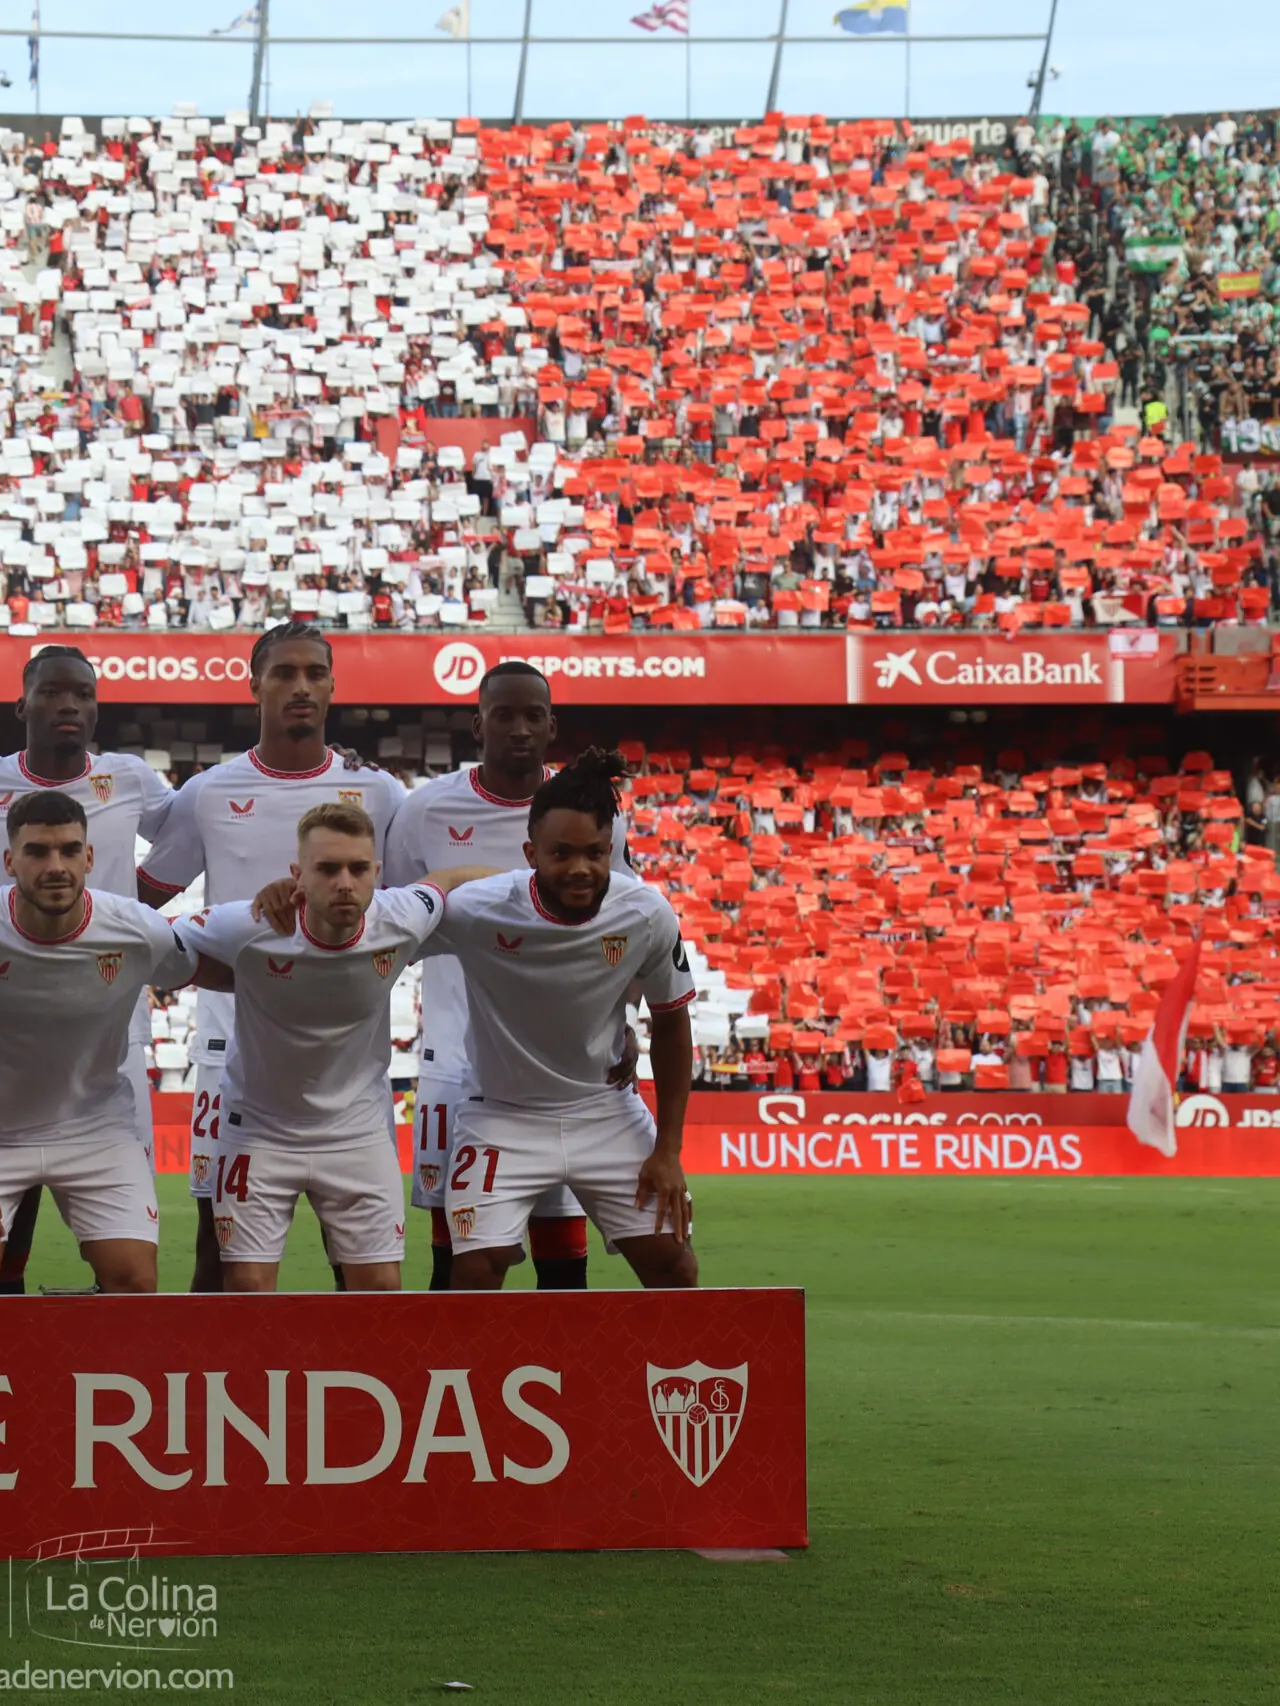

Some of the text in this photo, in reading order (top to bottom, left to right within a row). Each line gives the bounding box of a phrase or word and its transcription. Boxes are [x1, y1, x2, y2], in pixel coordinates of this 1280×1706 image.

[87, 656, 254, 681] SOCIOS.CO
[441, 656, 478, 682] JD
[499, 655, 705, 678] SPORTS.COM
[926, 651, 1104, 686] CaixaBank
[420, 1103, 448, 1151] 11
[451, 1145, 500, 1193] 21
[720, 1132, 1083, 1170] NUNCA TE RINDAS
[216, 1154, 251, 1203] 14
[71, 1364, 571, 1492] RINDAS
